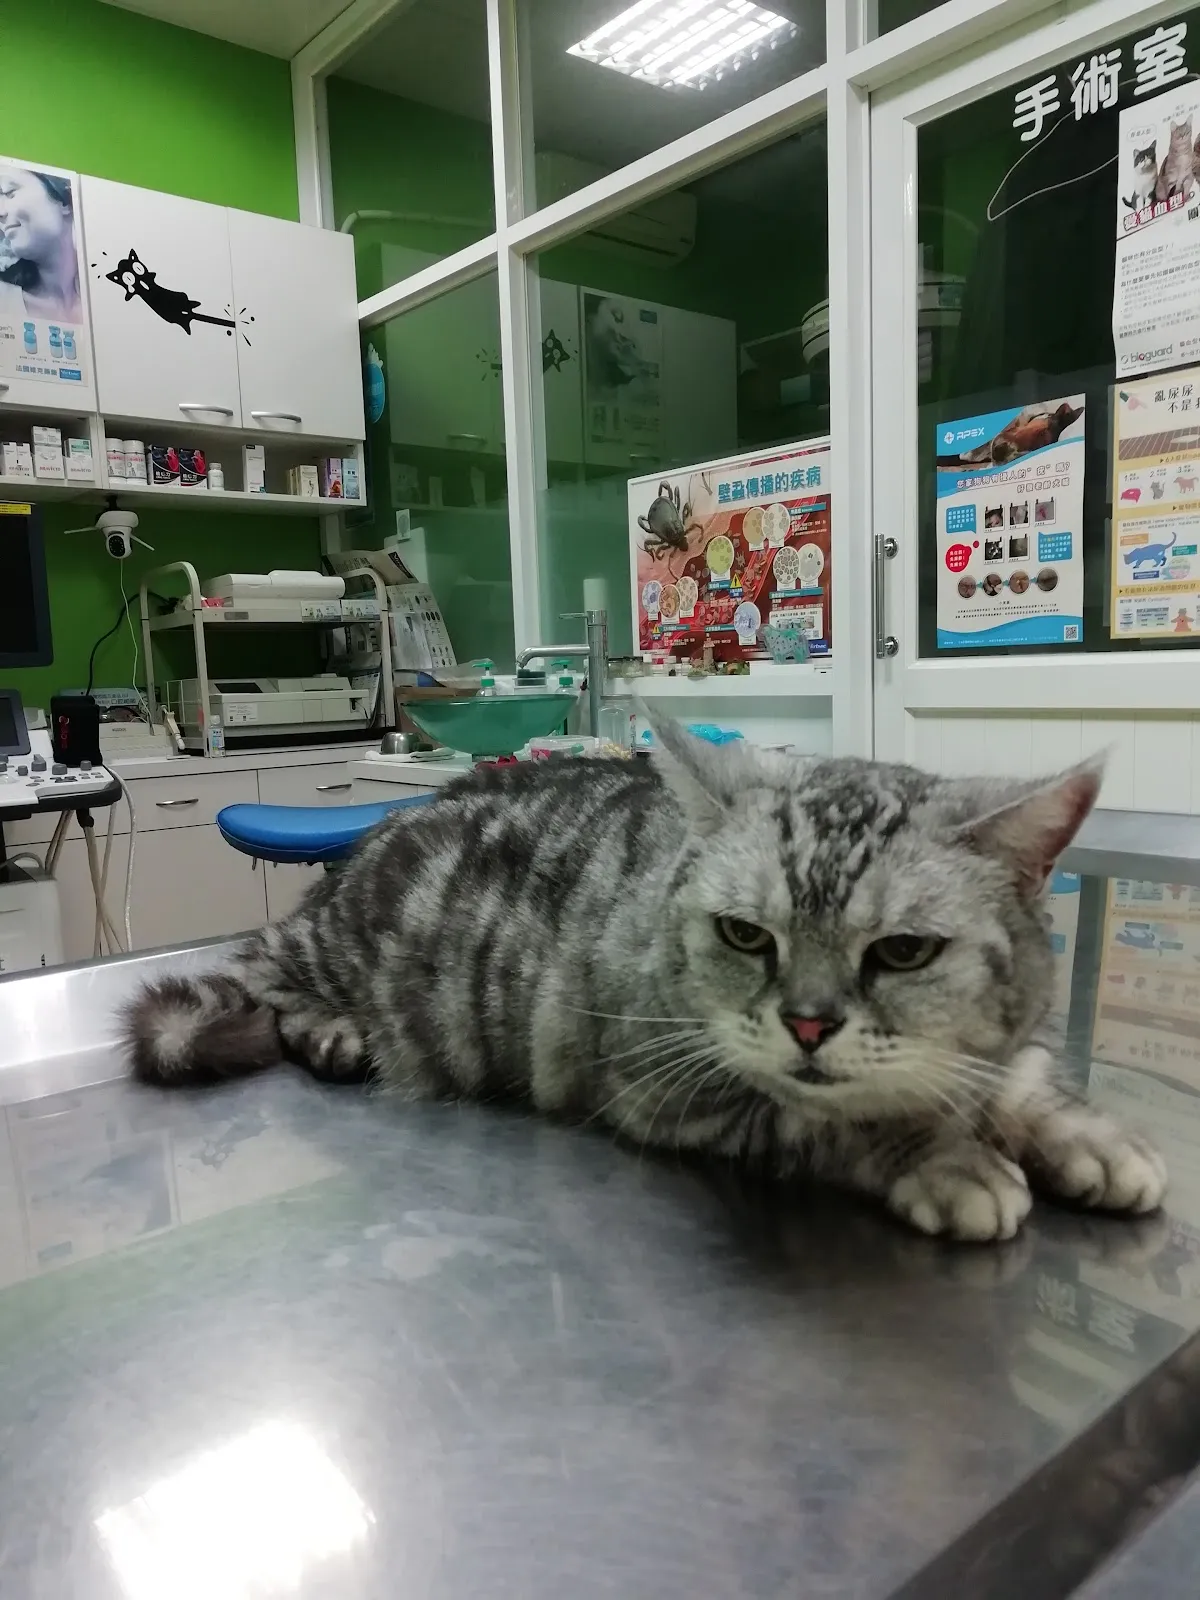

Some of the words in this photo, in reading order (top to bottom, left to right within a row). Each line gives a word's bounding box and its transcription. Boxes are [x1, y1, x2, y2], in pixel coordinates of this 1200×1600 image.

[1012, 22, 1188, 141] 手術室
[1154, 384, 1193, 403] 亂尿尿
[956, 426, 985, 441] APEX
[717, 465, 822, 505] 壁蝨傳播的疾病
